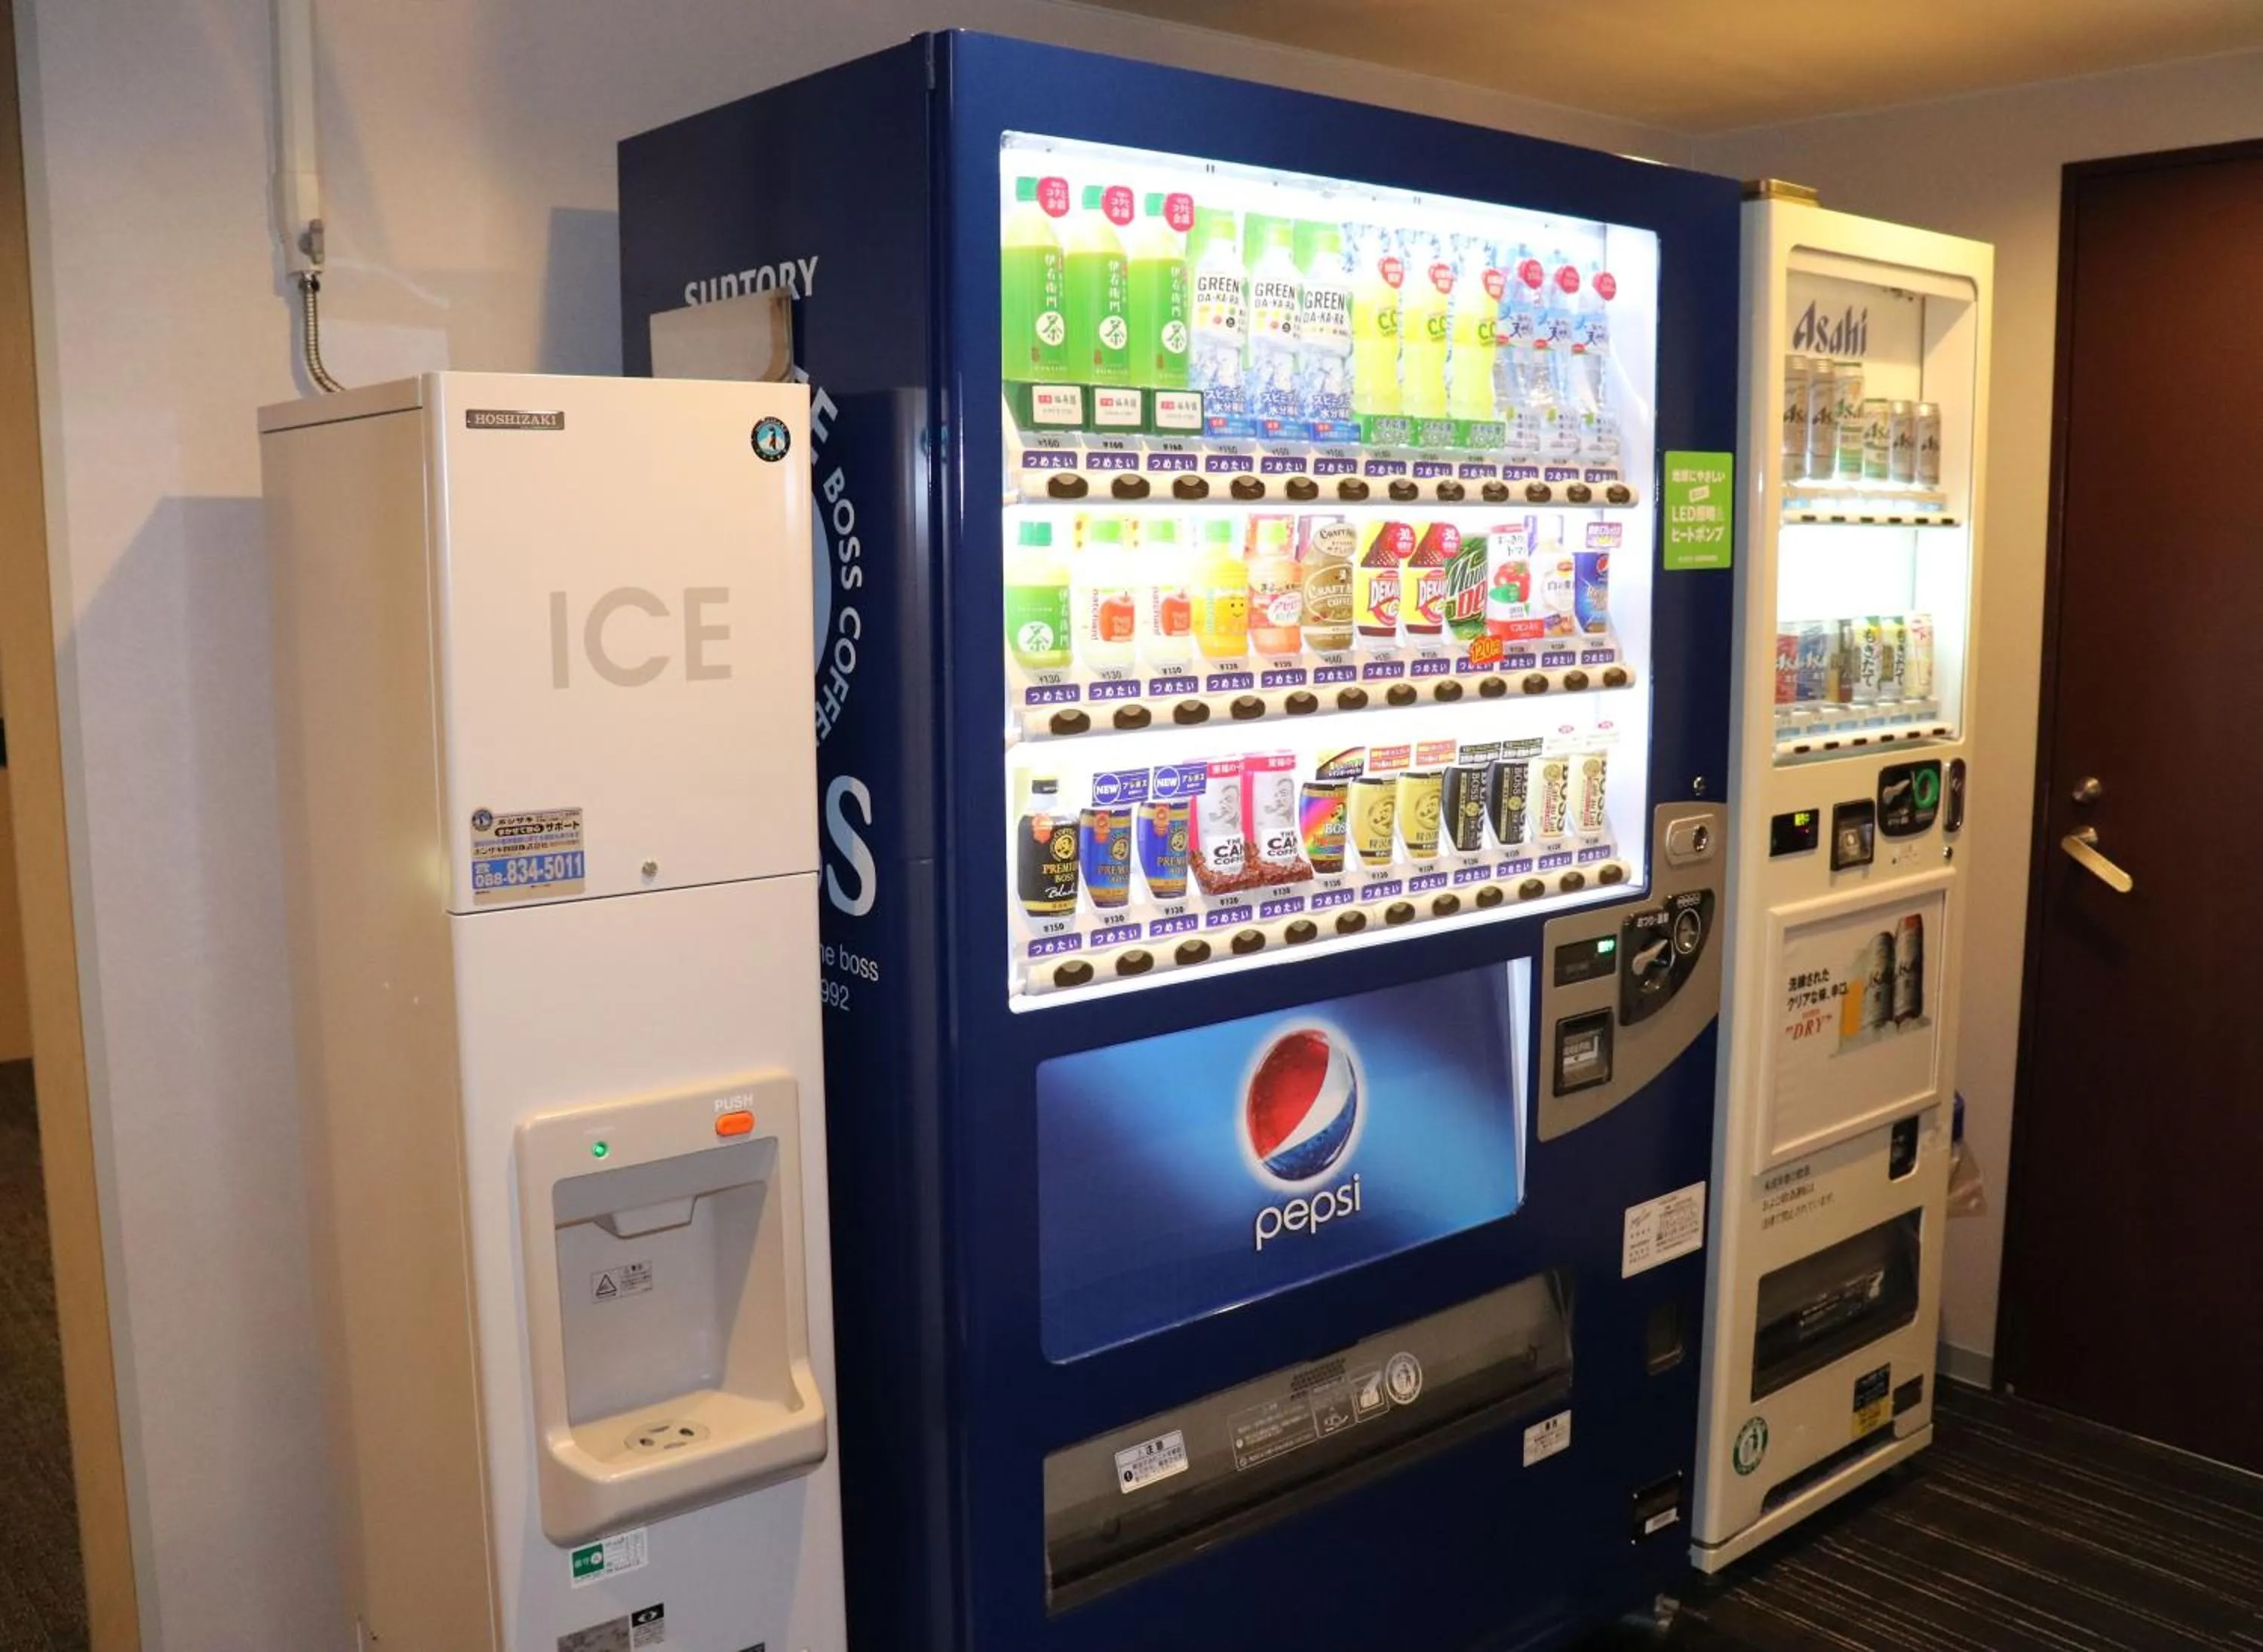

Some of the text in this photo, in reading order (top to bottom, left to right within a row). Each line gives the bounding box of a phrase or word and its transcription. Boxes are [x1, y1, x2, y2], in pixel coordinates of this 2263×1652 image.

[1198, 277, 1239, 293] GREEN
[1255, 282, 1295, 299] GREEN
[1305, 291, 1345, 311] GREEN
[1792, 299, 1868, 356] Asahi
[474, 414, 557, 425] HOSHIZAKI
[1027, 456, 1073, 467] つめたい
[1091, 458, 1135, 468] つめたい
[1152, 459, 1193, 470] つめたい
[1209, 460, 1250, 470] つめたい
[1264, 462, 1303, 471] つめたい
[1319, 463, 1354, 473] つめたい
[1368, 466, 1403, 475] つめたい
[1417, 468, 1450, 476] つめたい
[1461, 469, 1494, 477] つめたい
[815, 466, 863, 743] BOSS COFFE
[549, 586, 732, 689] ICE
[1318, 670, 1353, 680] つめたい
[1367, 666, 1401, 676] つめたい
[1413, 664, 1448, 674] つめたい
[1211, 677, 1250, 689] つめたい
[1264, 674, 1303, 685] つめたい
[1093, 685, 1138, 697] つめたい
[1153, 680, 1195, 692] つめたい
[1030, 689, 1076, 701] つめたい
[1156, 778, 1178, 790] NEW
[1096, 785, 1119, 798] NEW
[545, 821, 580, 831] サポート
[1042, 863, 1079, 874] PREMI
[1457, 870, 1489, 882] つめたい
[1412, 877, 1445, 889] つめたい
[1365, 885, 1400, 898] つめたい
[1316, 893, 1351, 905] つめたい
[1264, 902, 1301, 915] つめたい
[1209, 910, 1249, 923] つめたい
[1044, 923, 1064, 932] ¥150
[1153, 920, 1195, 933] つめたい
[1095, 929, 1138, 943] つめたい
[1032, 940, 1078, 953] つめたい
[840, 944, 879, 981] boss
[820, 979, 850, 1011] 992
[714, 1095, 754, 1112] PUSH
[1256, 1173, 1361, 1251] pepsi
